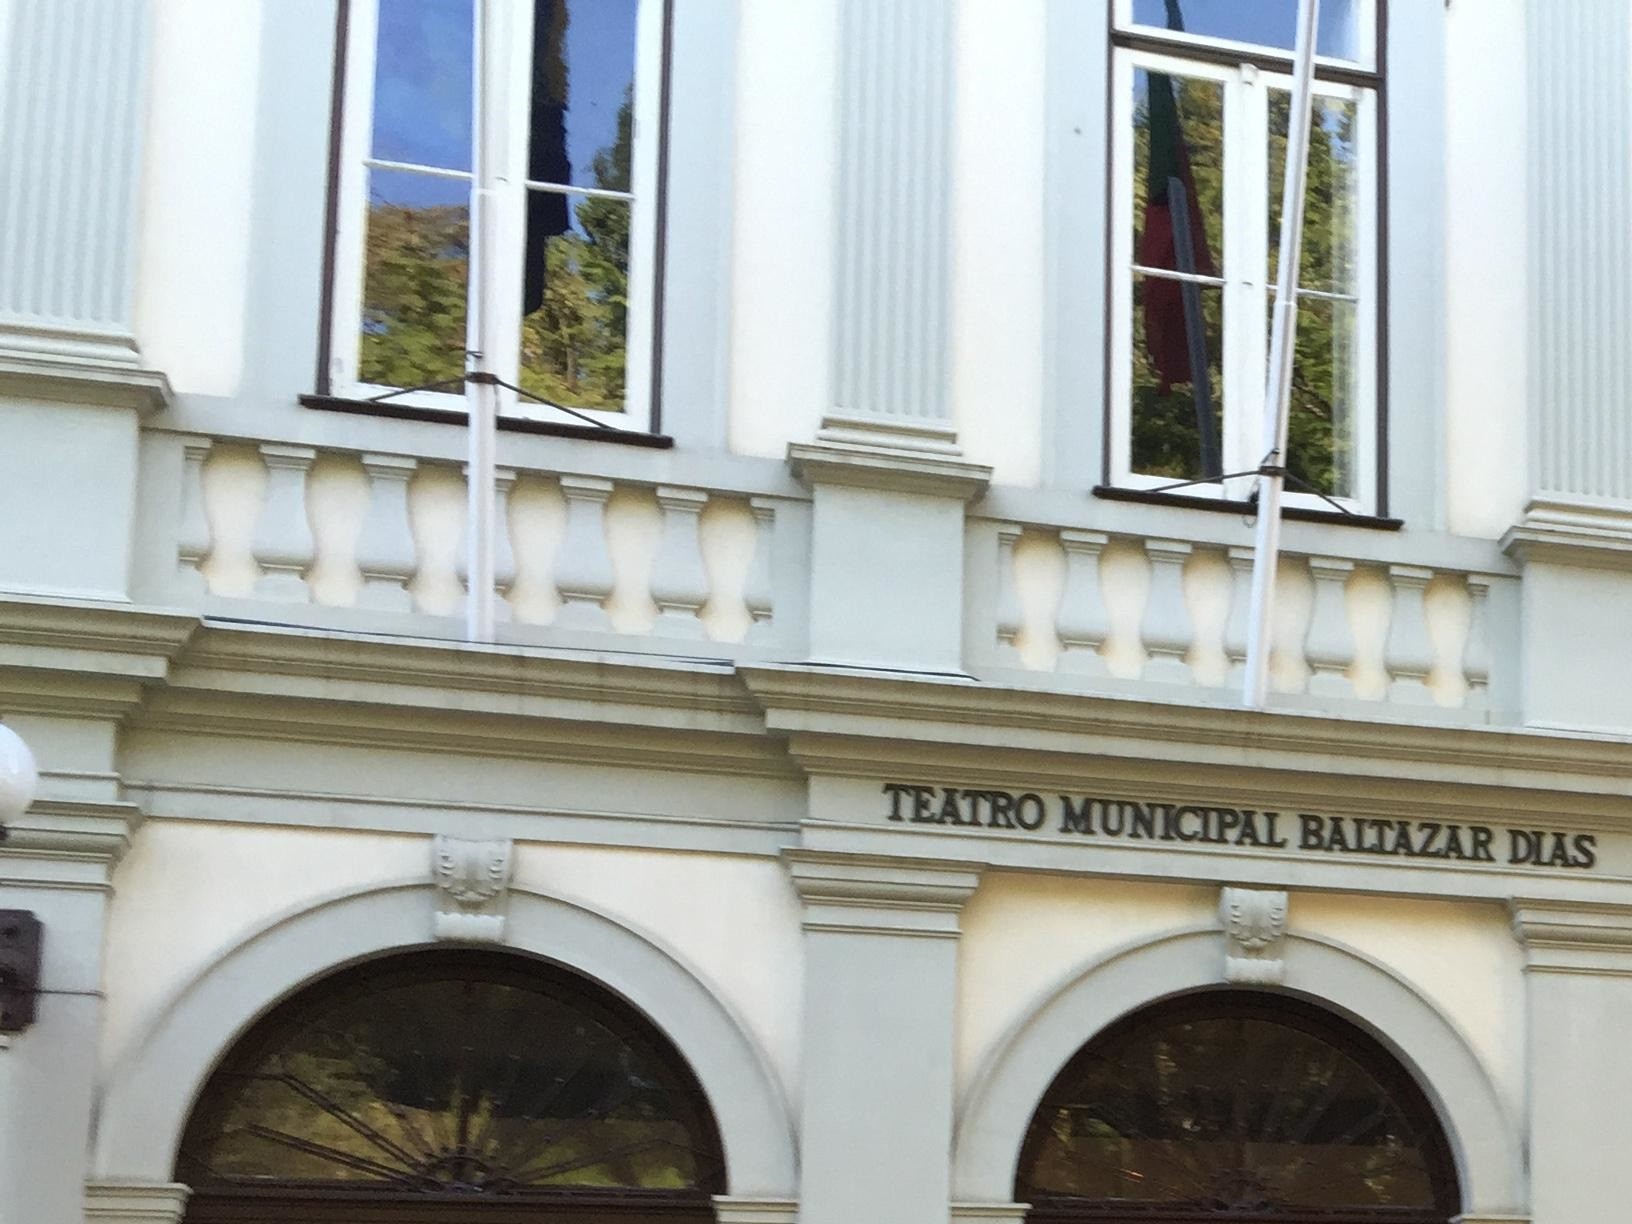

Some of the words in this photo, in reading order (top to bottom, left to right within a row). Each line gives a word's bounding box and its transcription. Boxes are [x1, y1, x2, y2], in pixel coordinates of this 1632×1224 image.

[882, 782, 1047, 831] TEATRO
[1057, 795, 1288, 849] MUNICIPAL
[1299, 814, 1496, 862] BALTAZAR
[1508, 829, 1599, 869] DIAS
